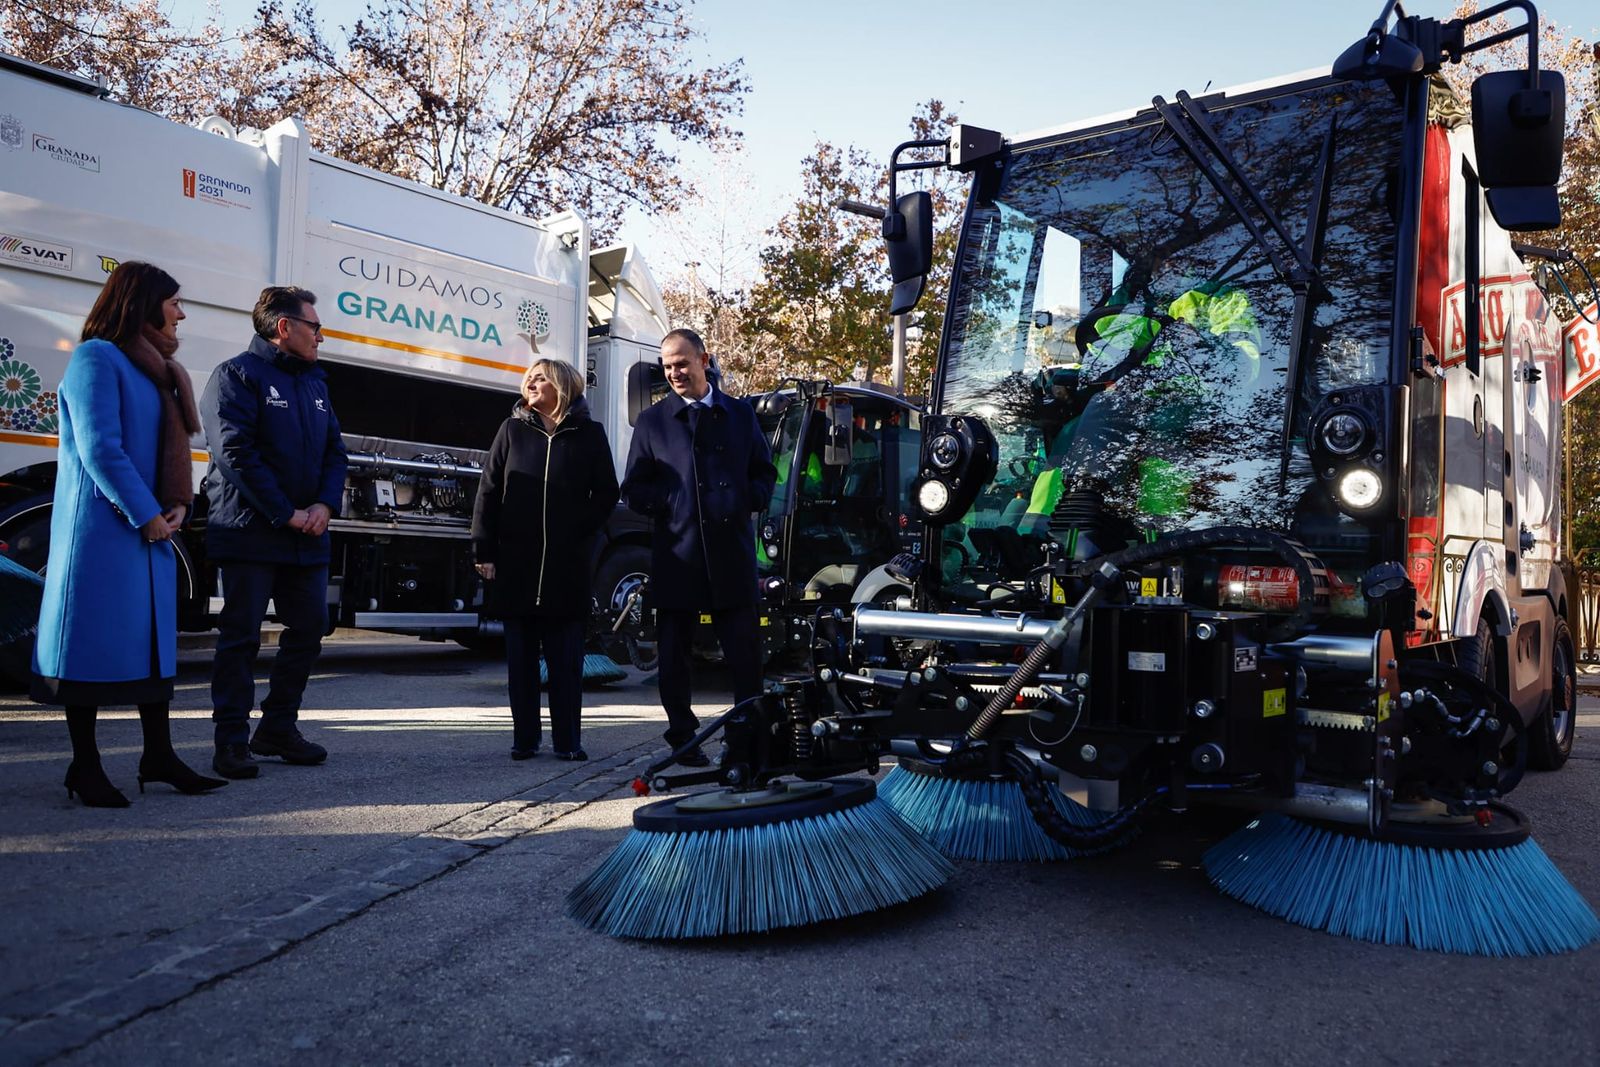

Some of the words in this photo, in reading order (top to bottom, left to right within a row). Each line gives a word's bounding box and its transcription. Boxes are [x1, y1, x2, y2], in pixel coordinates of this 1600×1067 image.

[35, 138, 97, 164] GRANADA
[51, 153, 85, 167] CIUDAD
[199, 183, 224, 197] 2031
[21, 245, 67, 262] SVAT
[338, 256, 503, 310] CUIDAMOS
[337, 291, 502, 346] GRANADA
